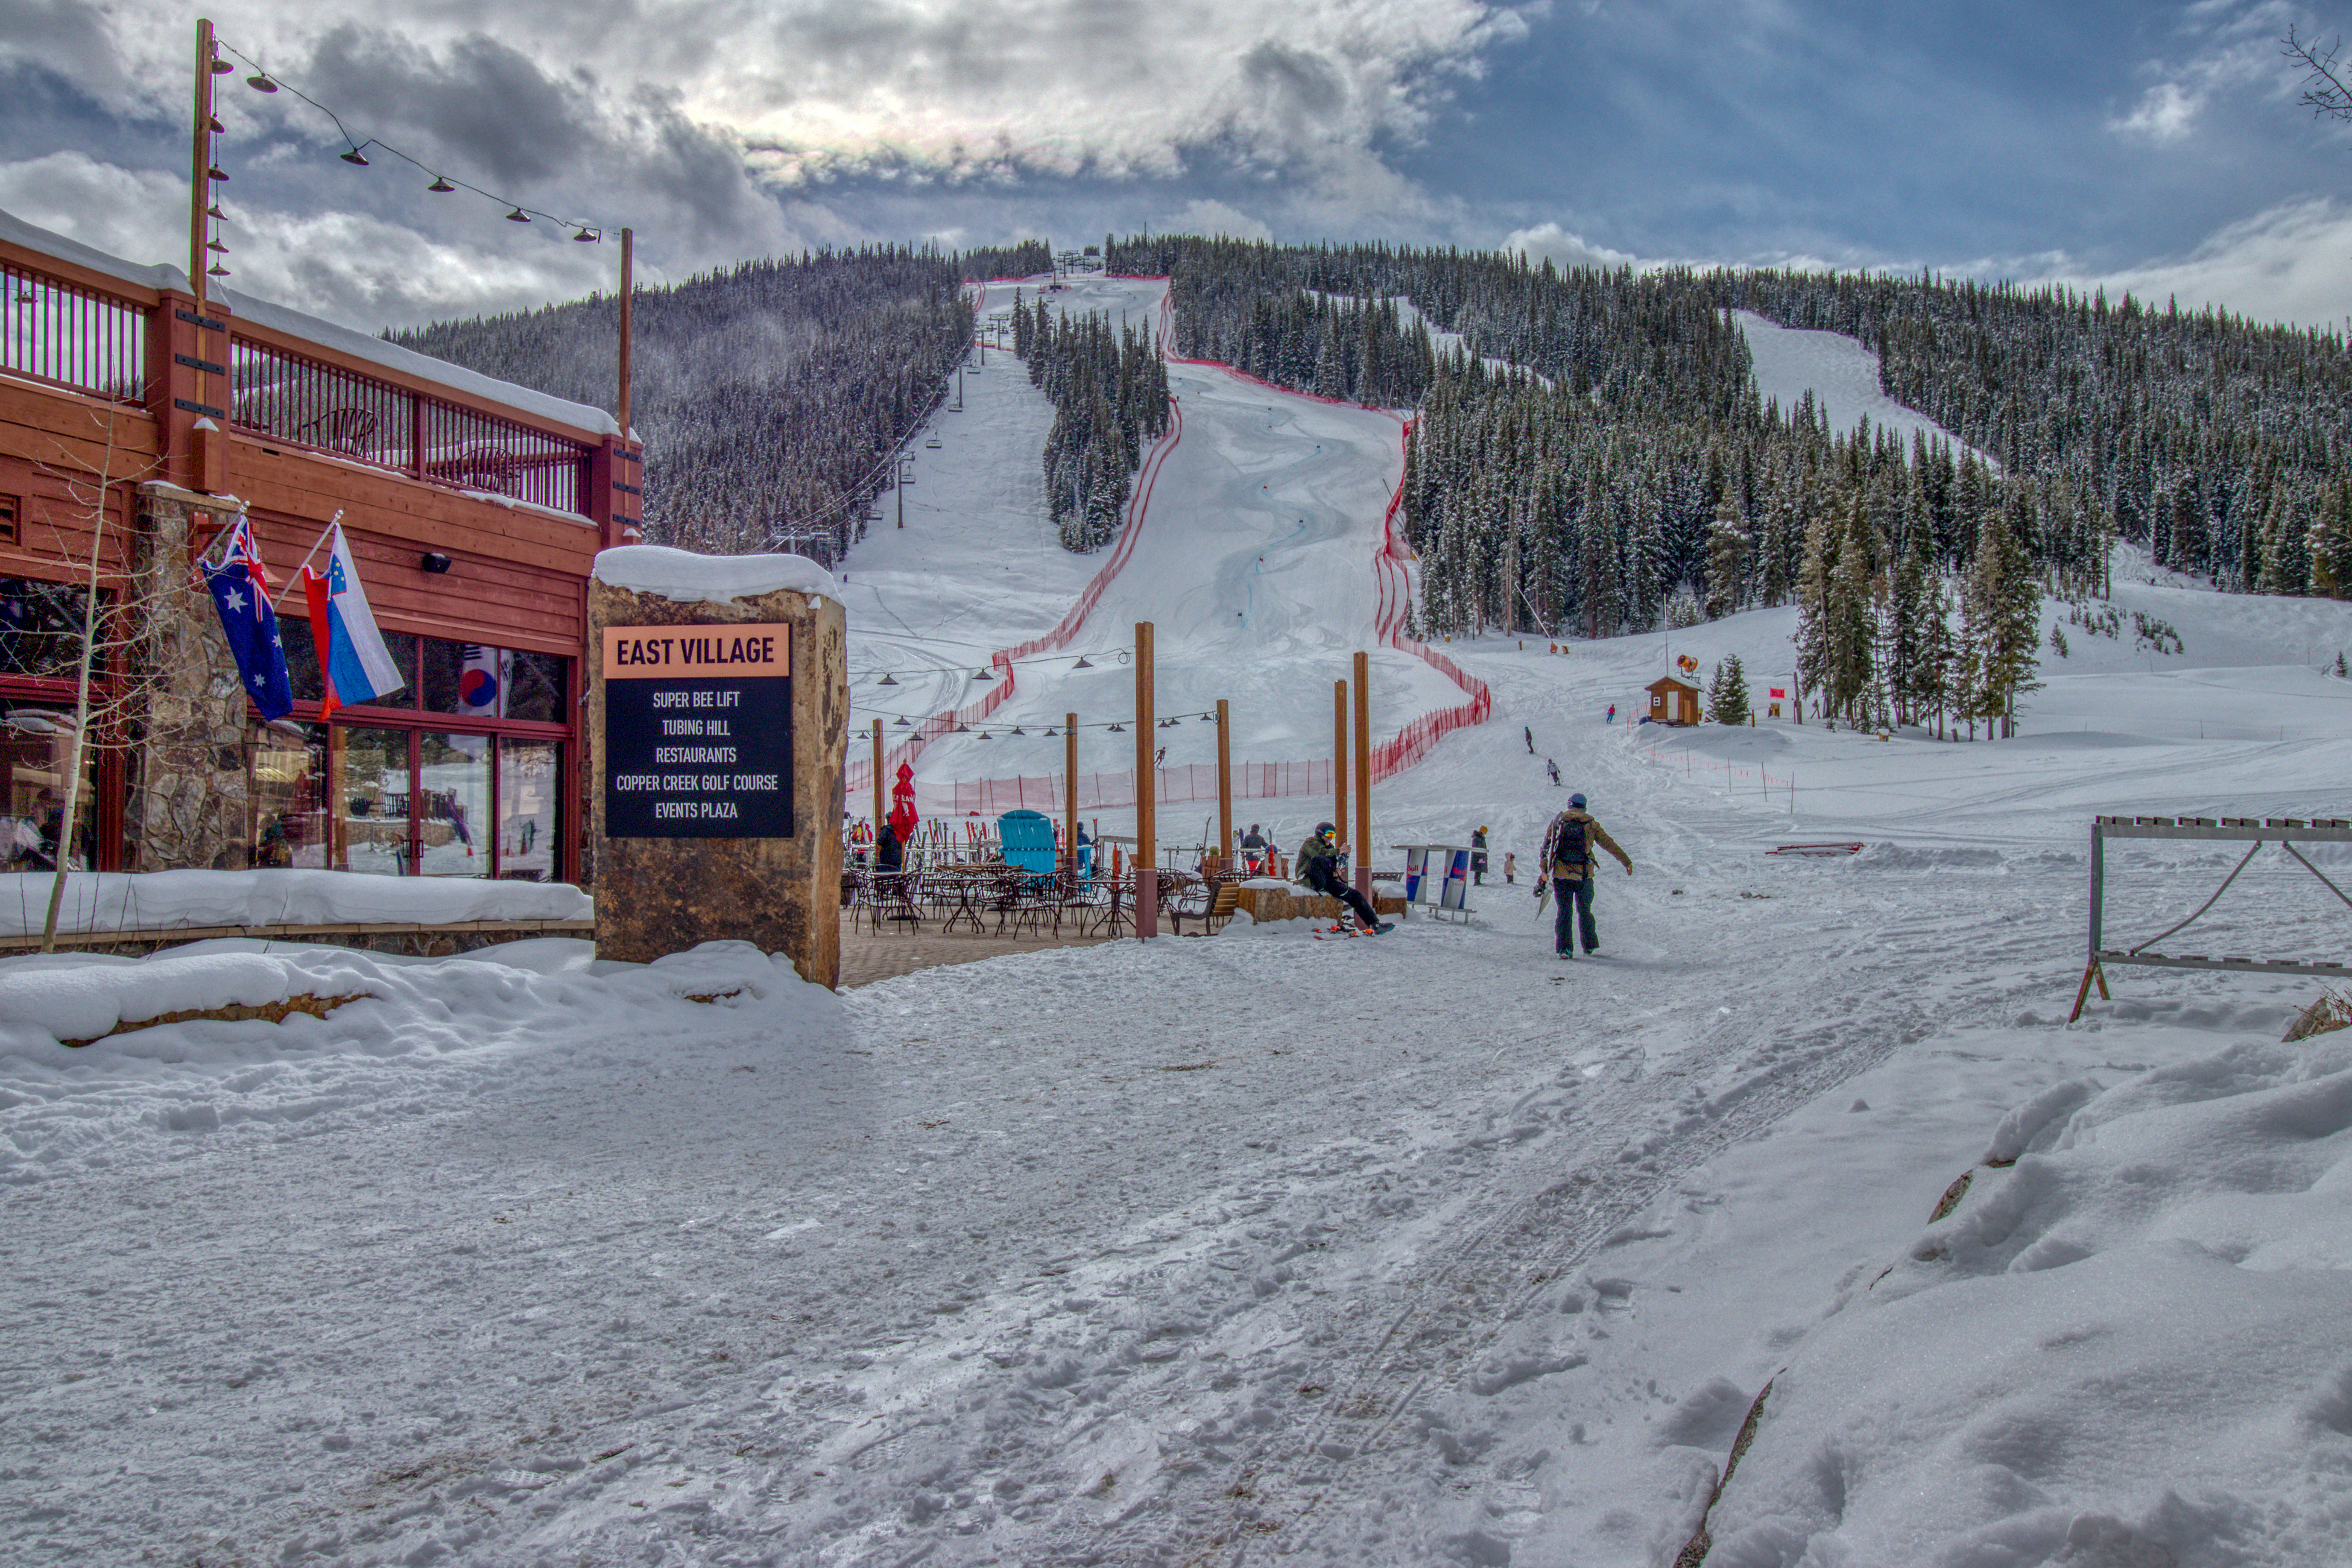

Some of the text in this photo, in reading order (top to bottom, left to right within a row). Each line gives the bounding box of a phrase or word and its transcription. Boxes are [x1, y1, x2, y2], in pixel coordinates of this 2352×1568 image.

[617, 637, 774, 665] EAST VILLAGE
[653, 691, 740, 708] SUPER BEE LIFT
[662, 719, 730, 736] TUBING HILL
[656, 747, 737, 763] RESTAURANTS
[616, 774, 778, 791] COPPER CREEK GOLF COURSE
[655, 803, 738, 818] EVENTS PLAZA
[1452, 867, 1467, 876] Red
